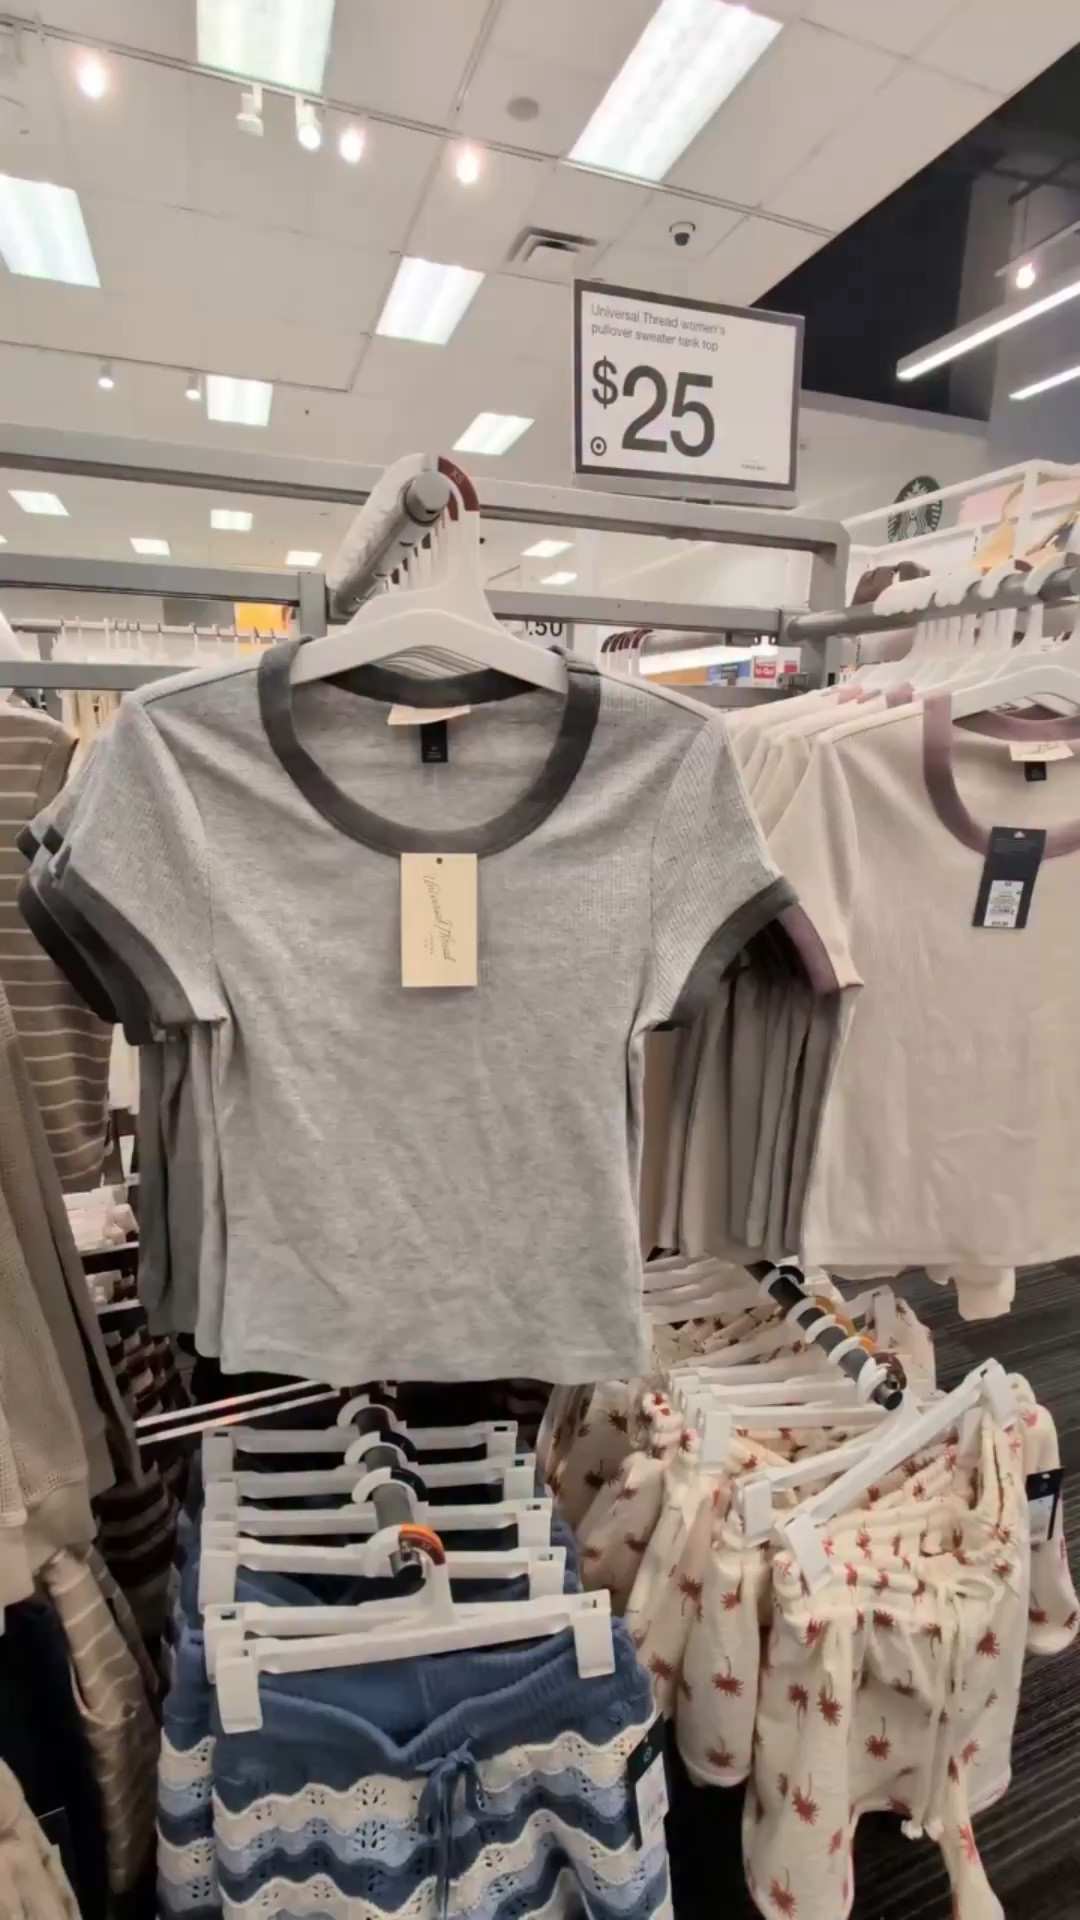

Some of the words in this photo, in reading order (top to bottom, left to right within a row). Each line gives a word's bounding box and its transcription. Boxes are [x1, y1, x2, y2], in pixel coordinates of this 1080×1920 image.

[591, 303, 640, 322] Universal
[643, 312, 679, 328] Thread
[681, 320, 726, 336] women's
[591, 324, 633, 338] pullover
[635, 331, 677, 344] sweater
[679, 336, 699, 349] tank
[702, 340, 719, 352] top
[592, 355, 715, 458] $25
